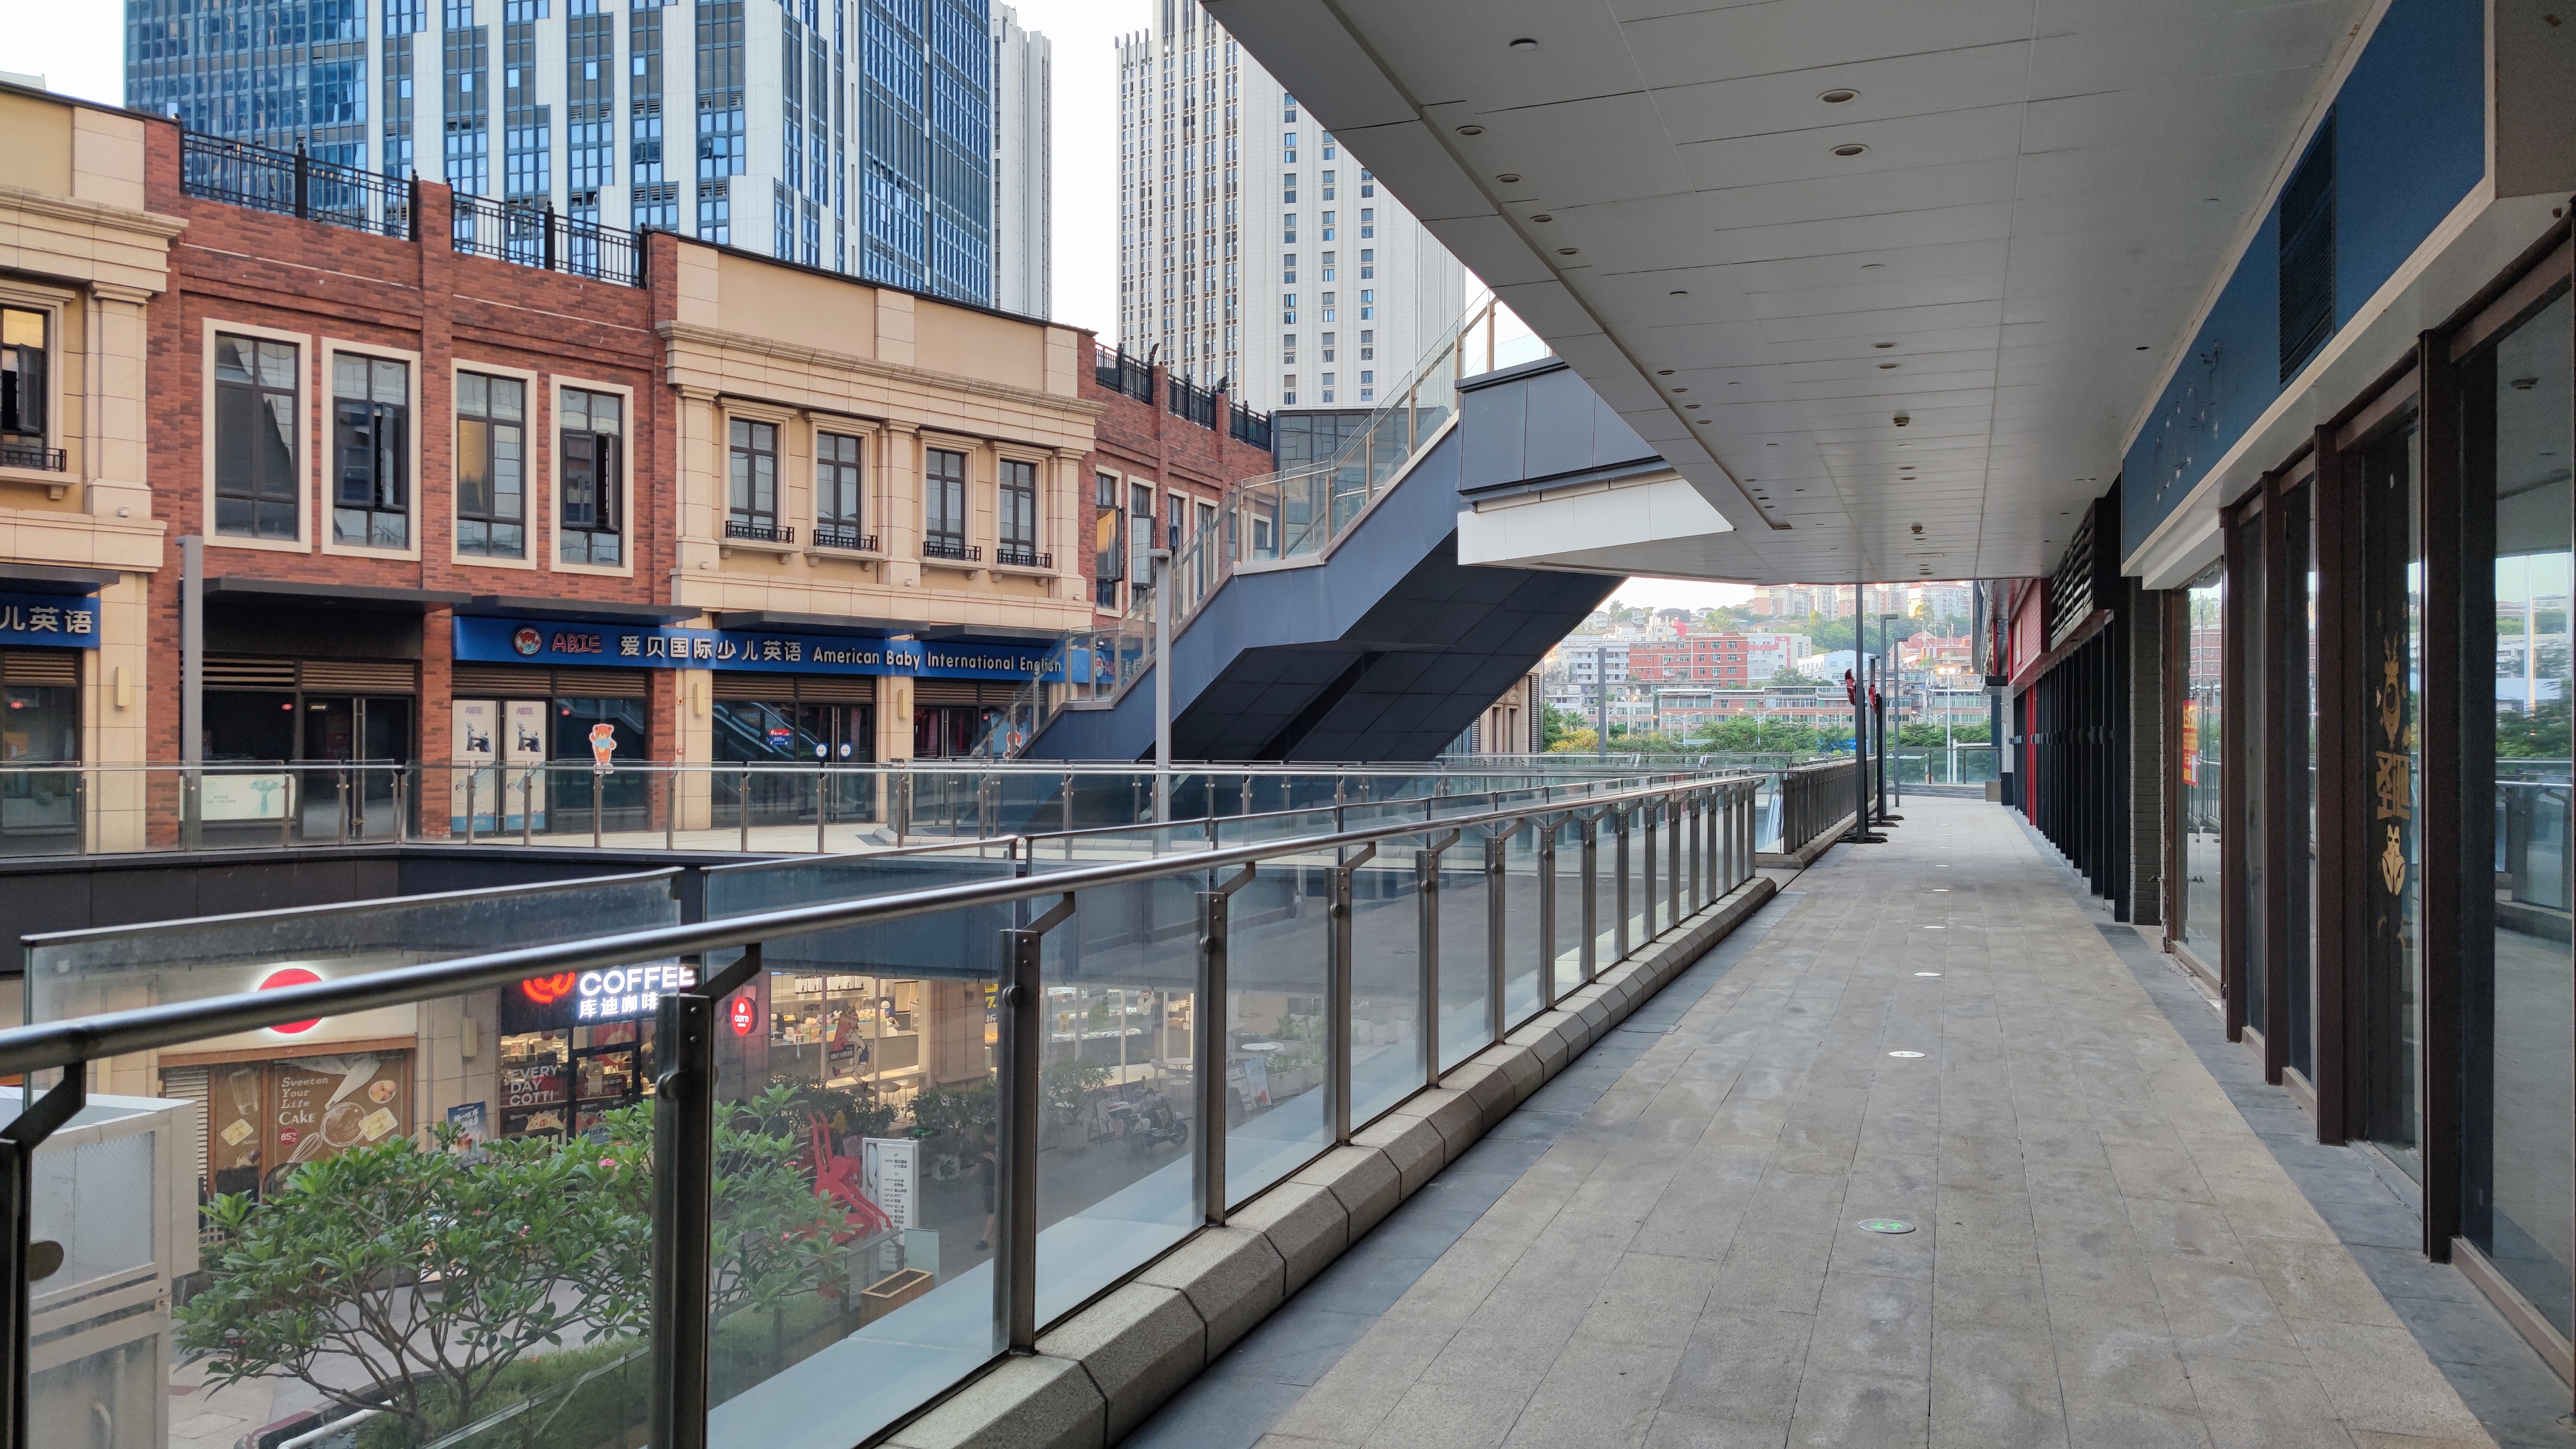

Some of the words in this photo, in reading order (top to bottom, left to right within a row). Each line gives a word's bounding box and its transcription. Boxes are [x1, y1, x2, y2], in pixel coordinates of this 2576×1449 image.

[0, 606, 92, 634] 儿英语
[552, 633, 603, 653] ABIE
[620, 635, 802, 662] 爱贝国际少儿英语
[813, 646, 880, 665] American
[886, 650, 920, 670] Baby
[927, 650, 1014, 671] International
[1020, 656, 1061, 675] English
[579, 966, 695, 997] COFFEE
[579, 991, 659, 1019] 库迪咖啡
[986, 995, 998, 1009] 7.
[734, 1014, 749, 1023] COTTI
[511, 1064, 558, 1080] EVERY
[282, 1077, 328, 1087] Sweeten
[510, 1080, 541, 1095] DAY
[282, 1088, 310, 1098] Your
[510, 1090, 554, 1106] COTTI
[280, 1099, 310, 1109] Life
